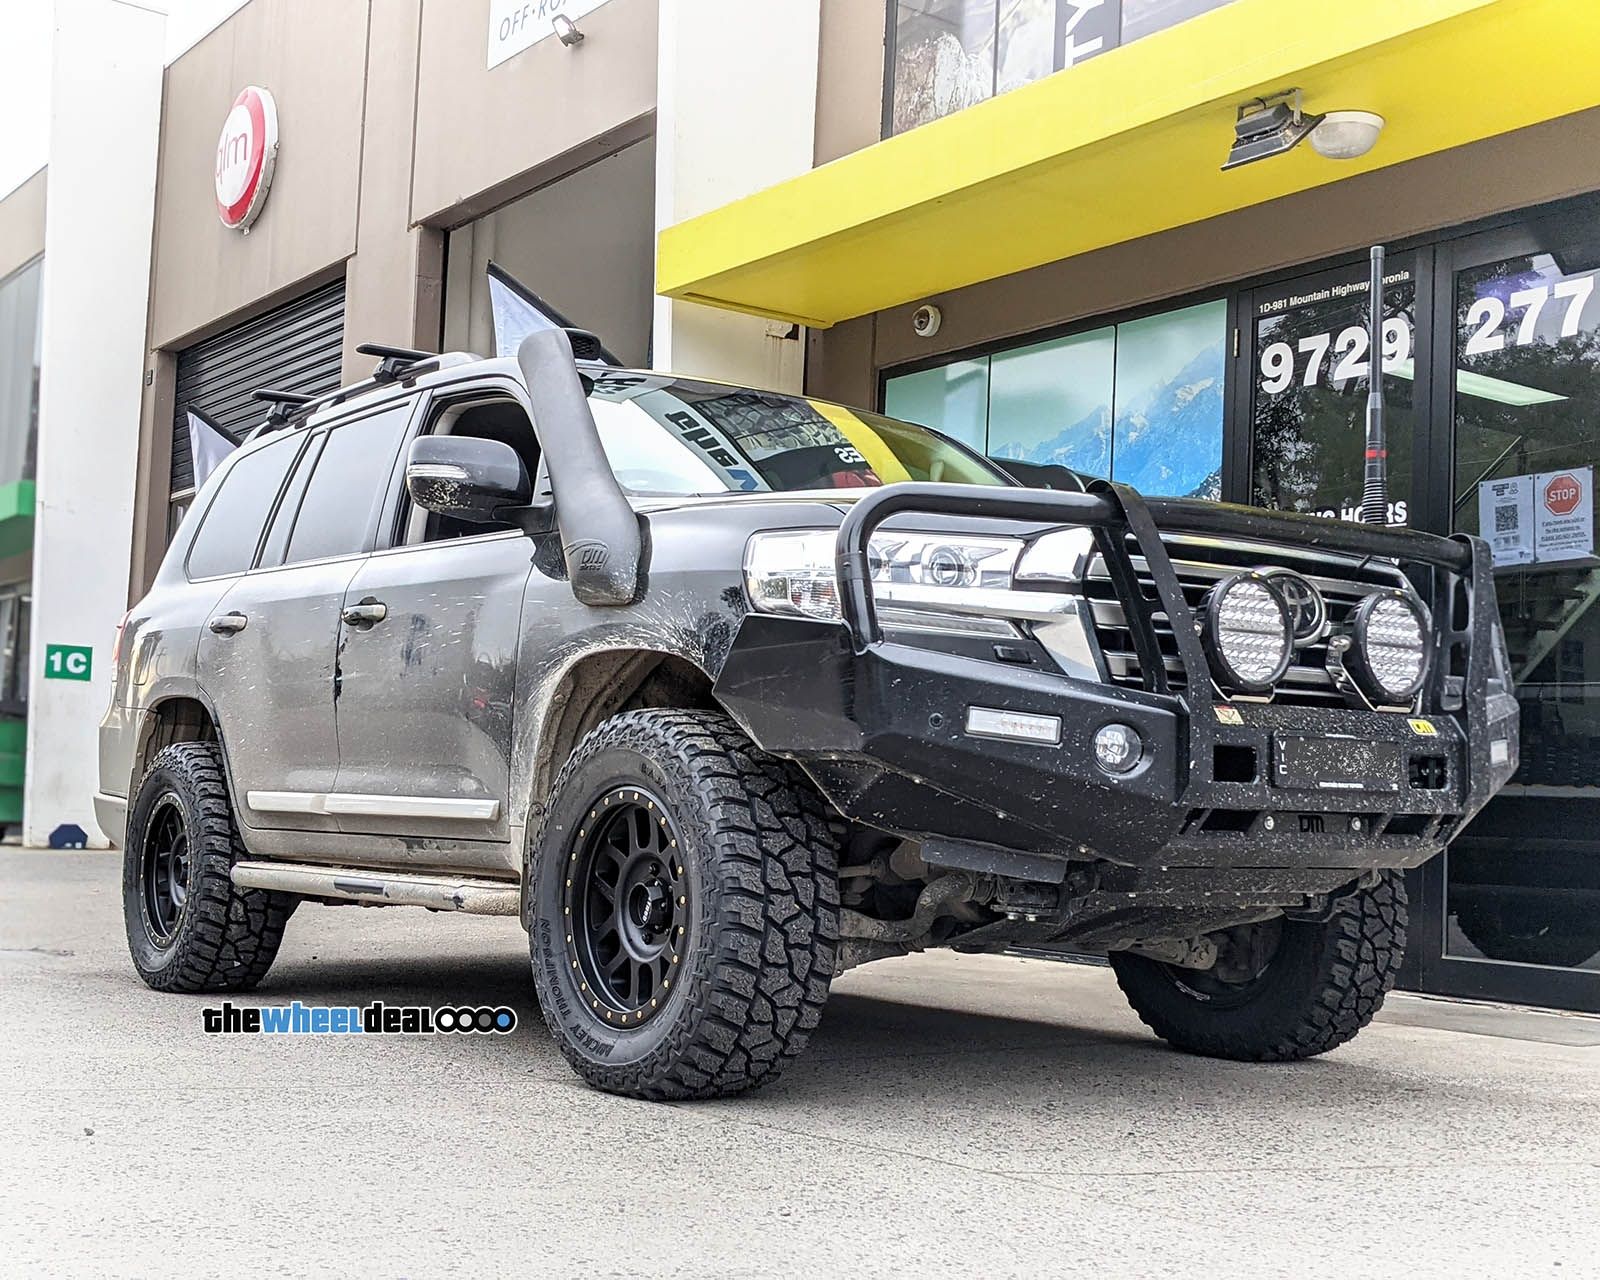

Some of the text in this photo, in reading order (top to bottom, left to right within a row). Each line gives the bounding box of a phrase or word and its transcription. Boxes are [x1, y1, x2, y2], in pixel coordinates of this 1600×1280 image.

[1258, 299, 1287, 314] 1D-981
[1289, 289, 1330, 307] Mountain
[1331, 280, 1371, 298] Highway
[1260, 275, 1594, 394] 9729 277
[1549, 488, 1577, 503] STOP
[50, 651, 88, 674] 1C
[1278, 740, 1288, 776] VIC
[540, 918, 616, 1058] MICKEY THOMPSON
